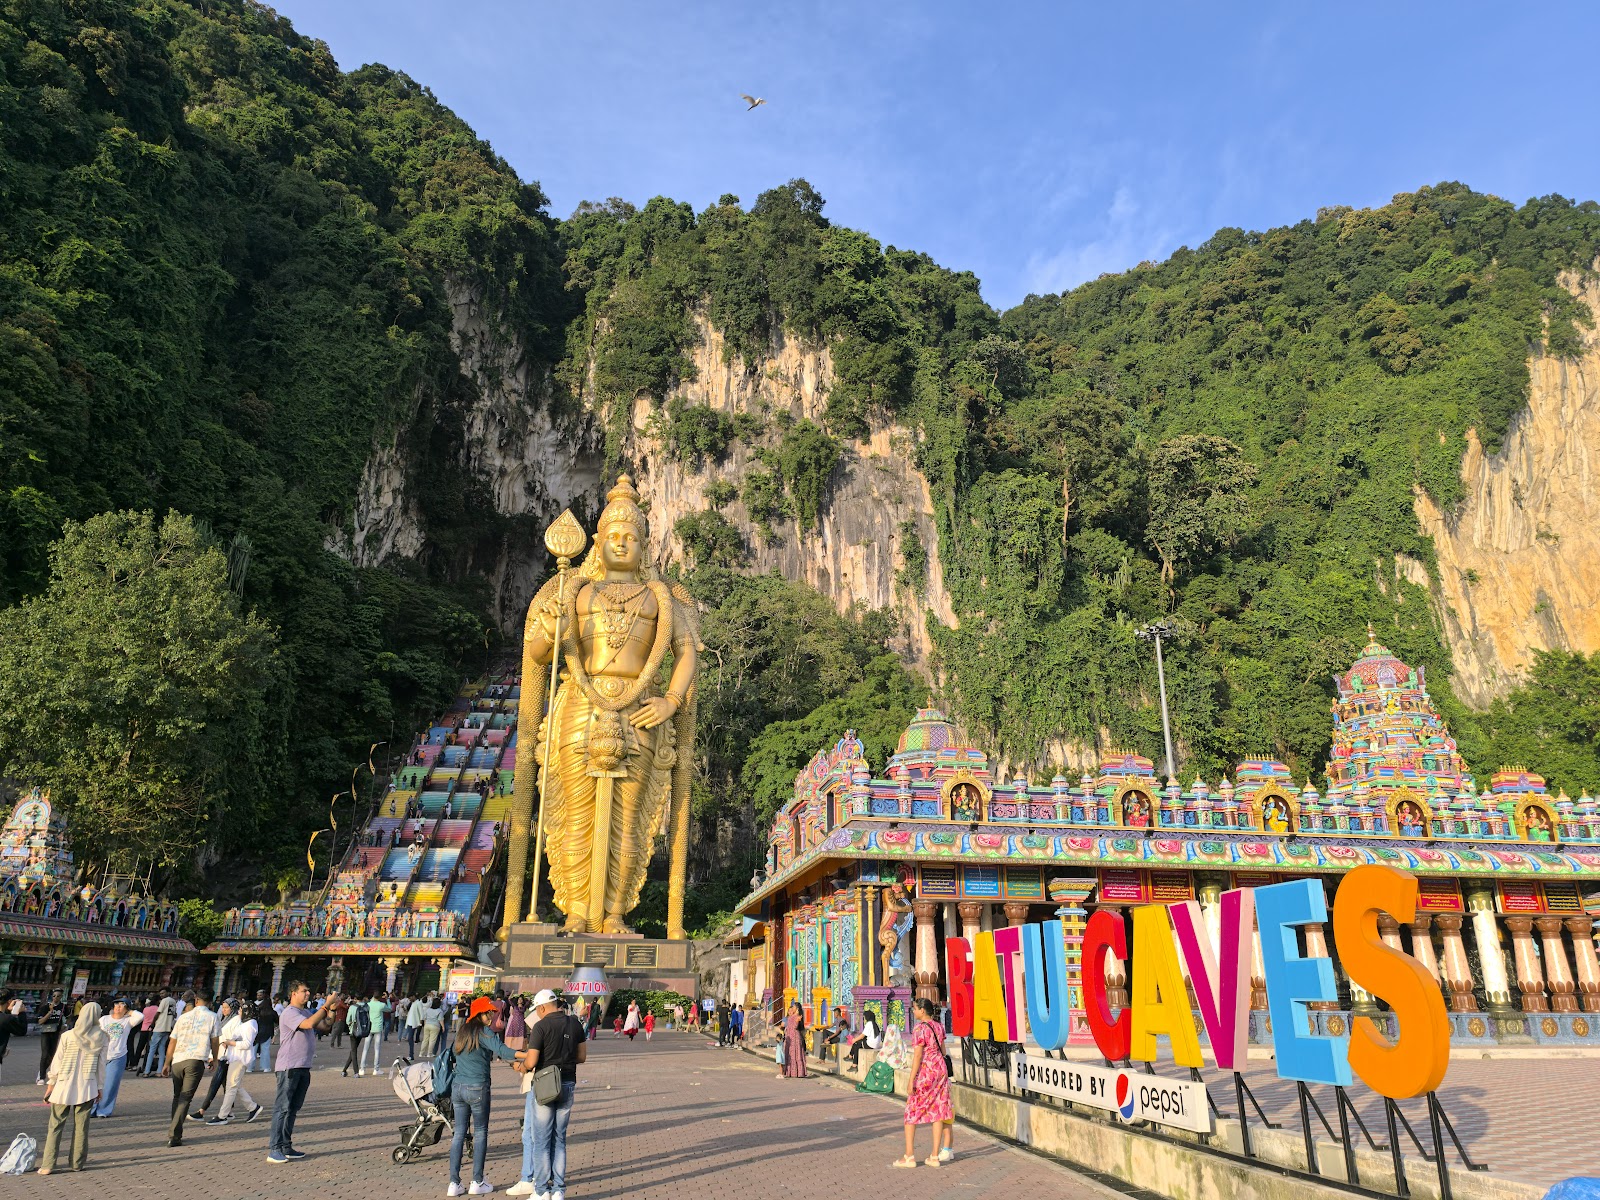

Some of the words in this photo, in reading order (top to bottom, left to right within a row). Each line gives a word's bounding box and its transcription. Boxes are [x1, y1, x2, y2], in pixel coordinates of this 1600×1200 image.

[946, 919, 1069, 1050] BATU
[1082, 864, 1450, 1099] CAVES
[1017, 1062, 1082, 1092] SPONSORED
[1090, 1076, 1106, 1098] BY
[1140, 1085, 1185, 1119] pepsi
